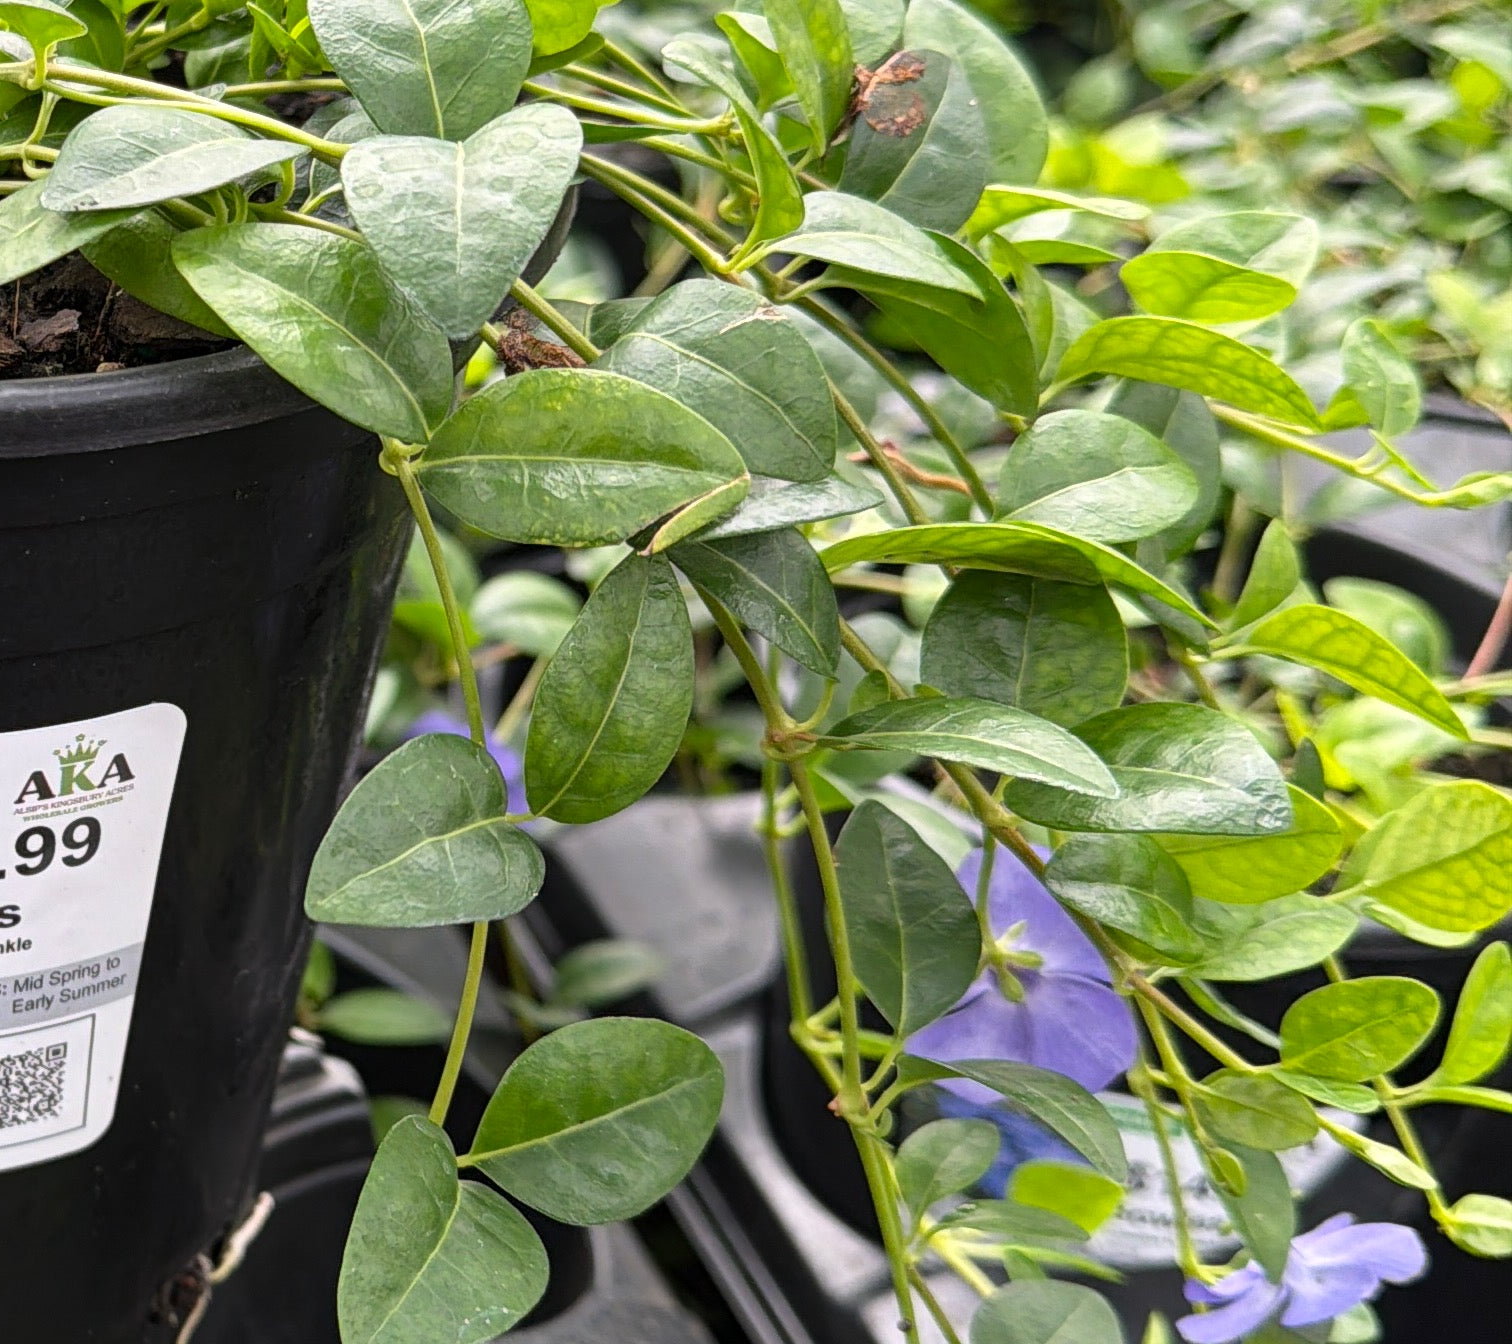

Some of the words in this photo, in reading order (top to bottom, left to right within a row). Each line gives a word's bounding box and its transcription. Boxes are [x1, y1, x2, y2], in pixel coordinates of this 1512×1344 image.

[14, 752, 136, 805] AKA
[105, 783, 135, 798] ACRES
[12, 994, 55, 1014] Early
[59, 973, 127, 1003] Summer
[13, 975, 44, 994] Mid
[49, 962, 100, 987] Spring
[106, 956, 121, 970] to
